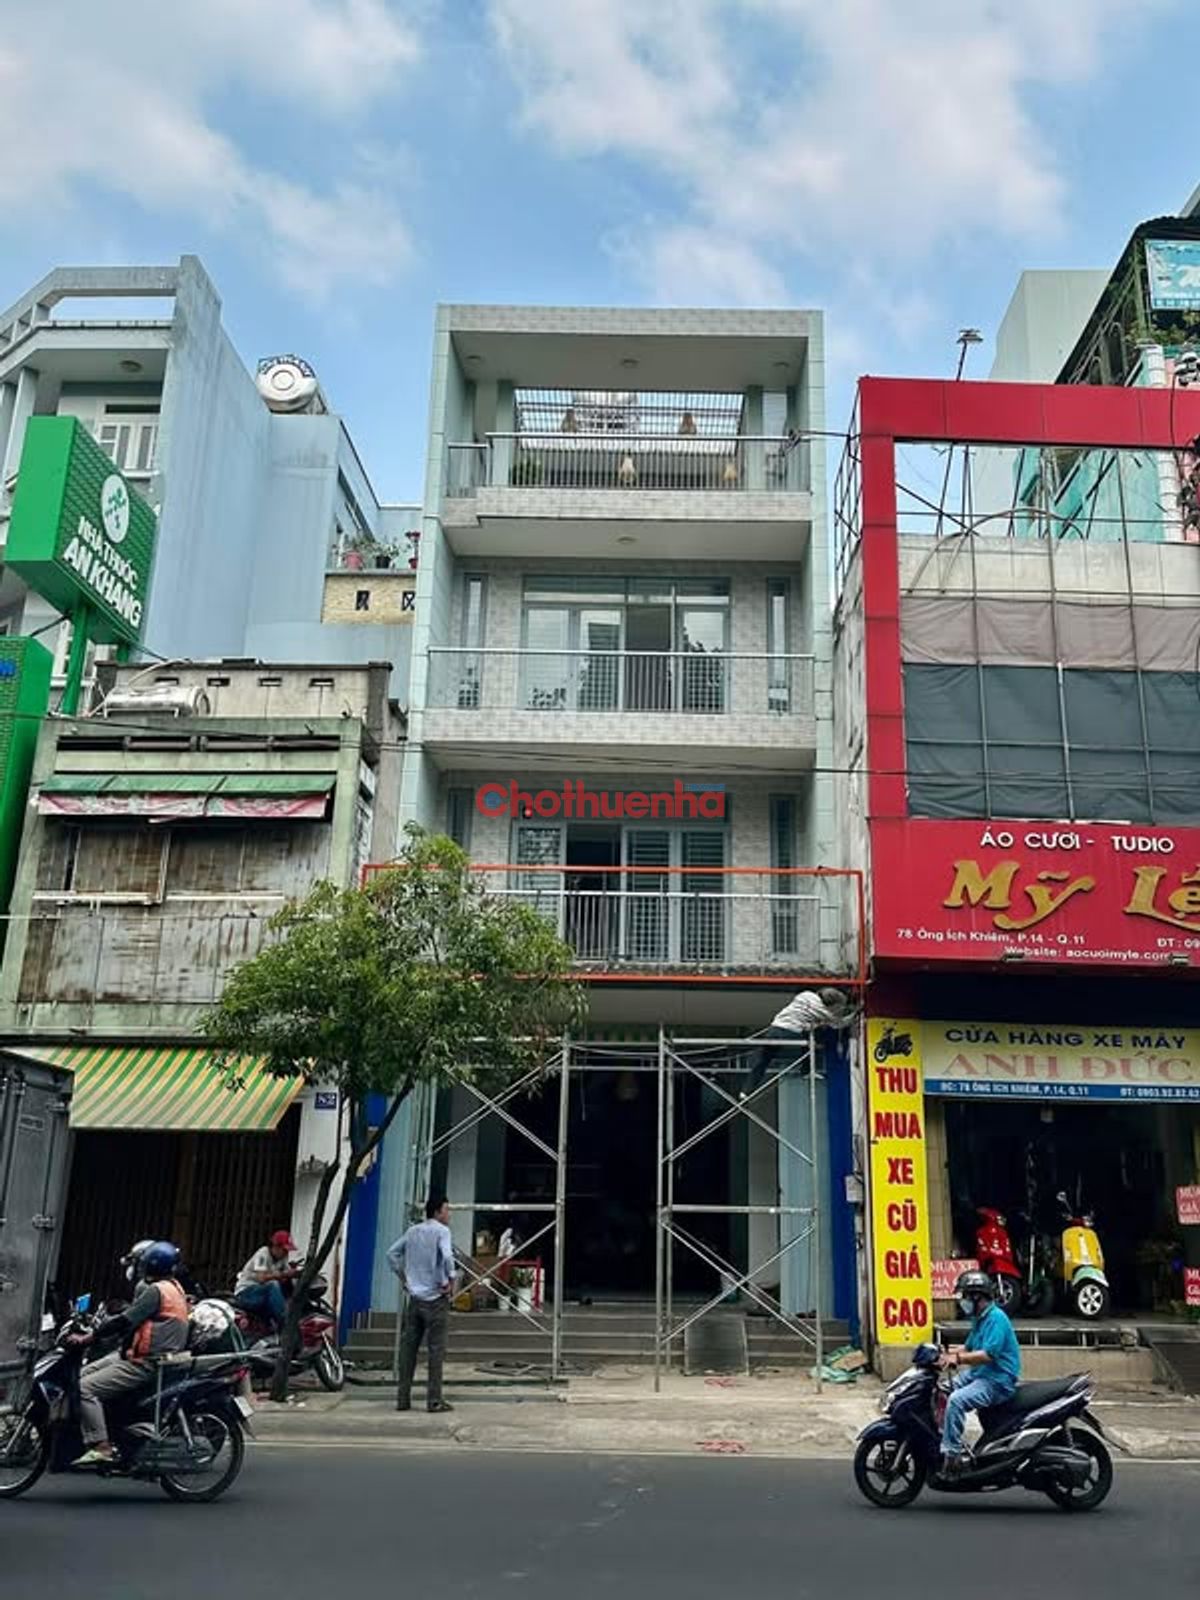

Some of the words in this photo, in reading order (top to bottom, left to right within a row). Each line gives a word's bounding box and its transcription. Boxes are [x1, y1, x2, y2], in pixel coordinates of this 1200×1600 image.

[64, 537, 92, 579] AN
[88, 560, 142, 627] KHANG
[980, 826, 1014, 848] ÁO
[1111, 835, 1174, 853] TUDIO
[943, 860, 1096, 931] Mỹ
[946, 1024, 999, 1043] CỬA
[1009, 1027, 1083, 1046] HÀNG
[1093, 1033, 1123, 1047] XE
[944, 1053, 1059, 1079] ANH
[1081, 1049, 1194, 1081] ĐỨC
[876, 1067, 918, 1094] THU
[875, 1112, 922, 1138] MUA
[888, 1158, 913, 1184] XE
[888, 1198, 917, 1231] CŨ
[885, 1244, 922, 1279] GIÁ
[884, 1299, 928, 1328] CAO
